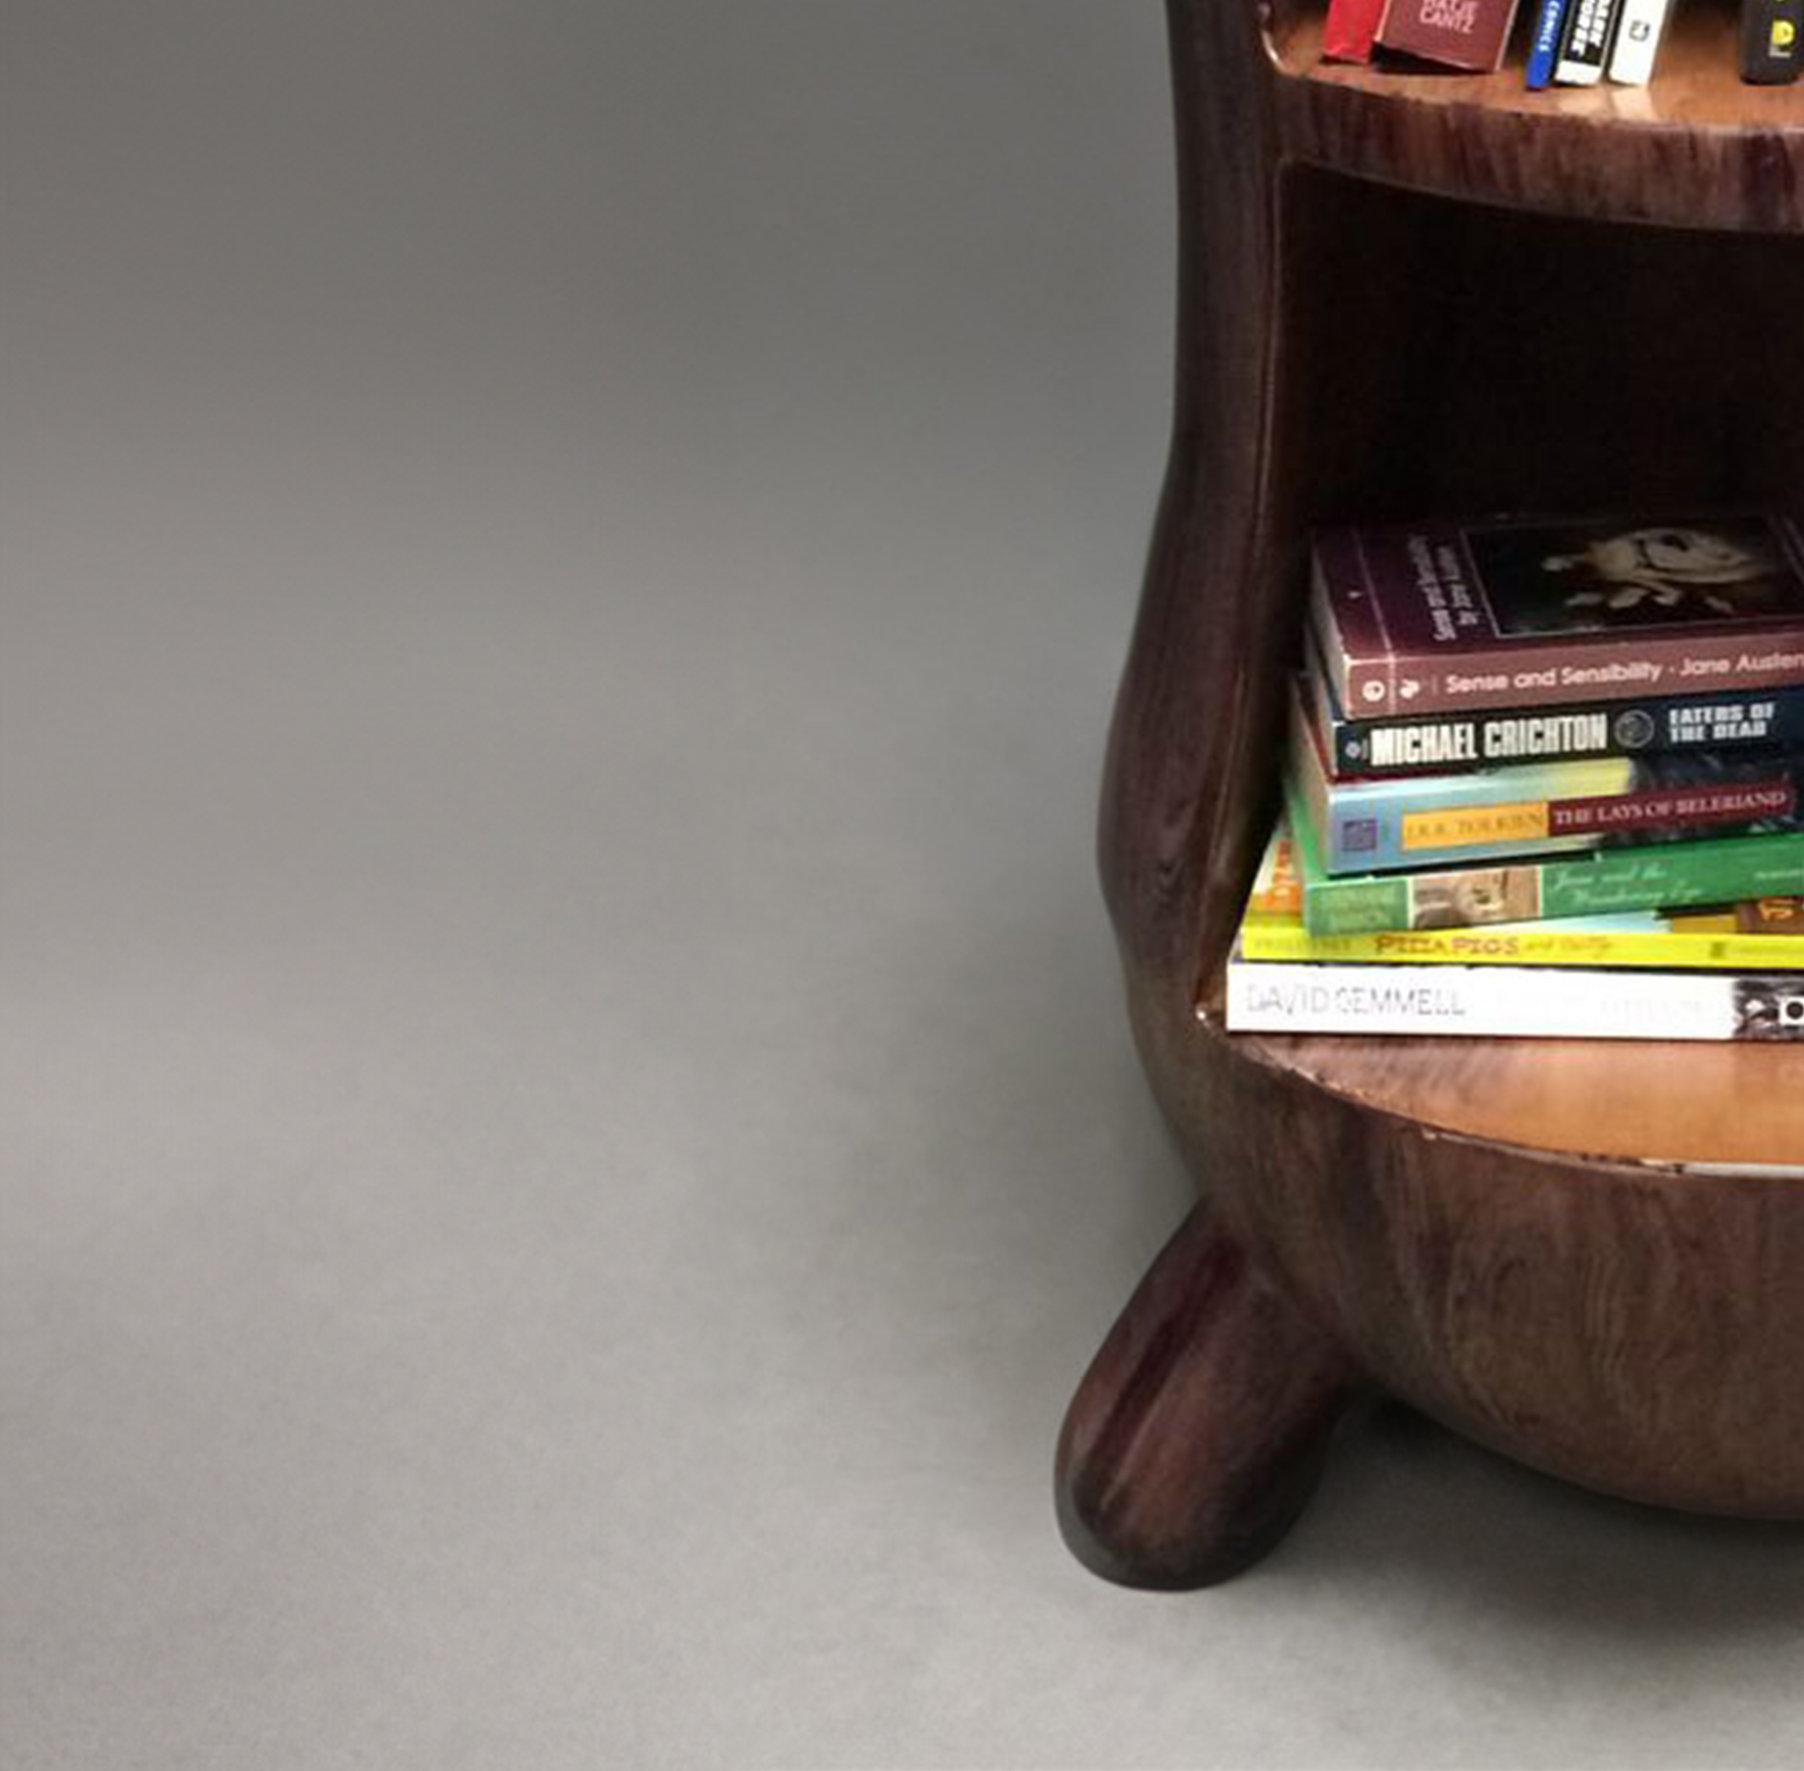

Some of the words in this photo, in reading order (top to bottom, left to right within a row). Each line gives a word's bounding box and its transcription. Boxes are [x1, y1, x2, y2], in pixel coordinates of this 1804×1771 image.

[1537, 0, 1560, 52] COMICS
[1446, 674, 1508, 694] Sense
[1514, 668, 1555, 688] and
[1561, 661, 1664, 685] Sensibility
[1680, 657, 1730, 677] Jane
[1669, 705, 1743, 725] EATERS
[1750, 702, 1775, 720] OF
[1370, 723, 1477, 766] MICHAEL
[1484, 713, 1607, 758] CRICHTON
[1670, 725, 1705, 743] THE
[1713, 720, 1767, 739] DEAD
[1459, 811, 1546, 835] TOLKIEN
[1555, 809, 1589, 825] THE
[1597, 804, 1642, 821] LAYS
[1646, 801, 1670, 818] OF
[1676, 791, 1787, 815] BELERIAND
[1247, 986, 1329, 1015] DAVID
[1336, 988, 1466, 1016] GEMMELL
